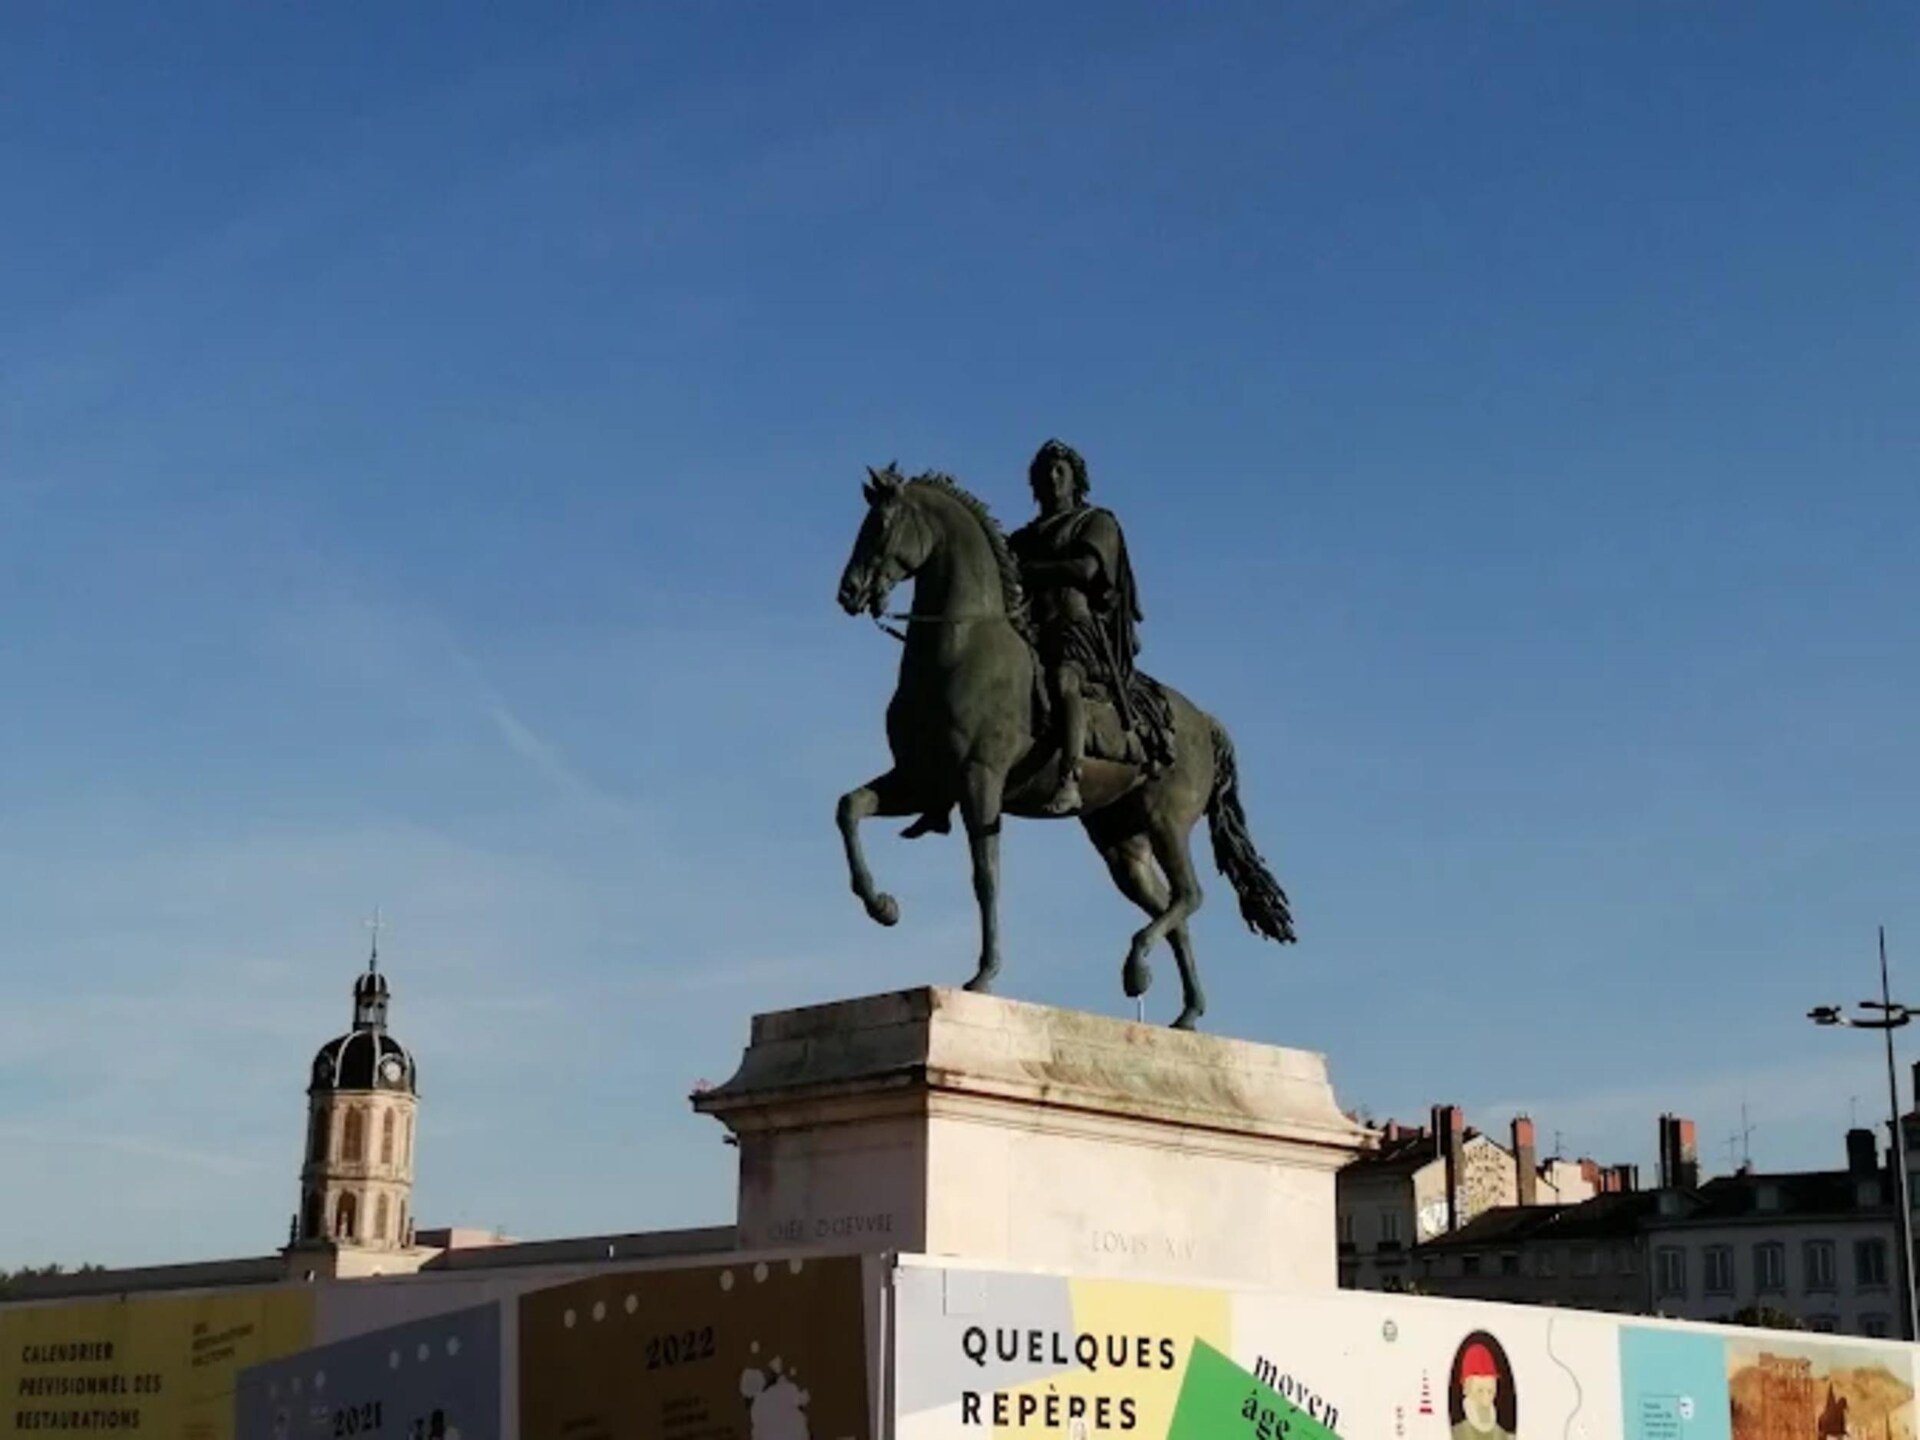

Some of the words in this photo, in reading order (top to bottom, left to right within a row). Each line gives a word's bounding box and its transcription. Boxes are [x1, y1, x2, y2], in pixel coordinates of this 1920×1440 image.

[22, 1342, 113, 1363] CALENDRIER
[646, 1326, 716, 1370] 2022
[962, 1326, 1176, 1371] QUELQUES
[134, 1374, 162, 1394] DES
[1253, 1355, 1339, 1430] moyen
[15, 1409, 140, 1431] RESTAURATIONS
[333, 1401, 382, 1437] 2021
